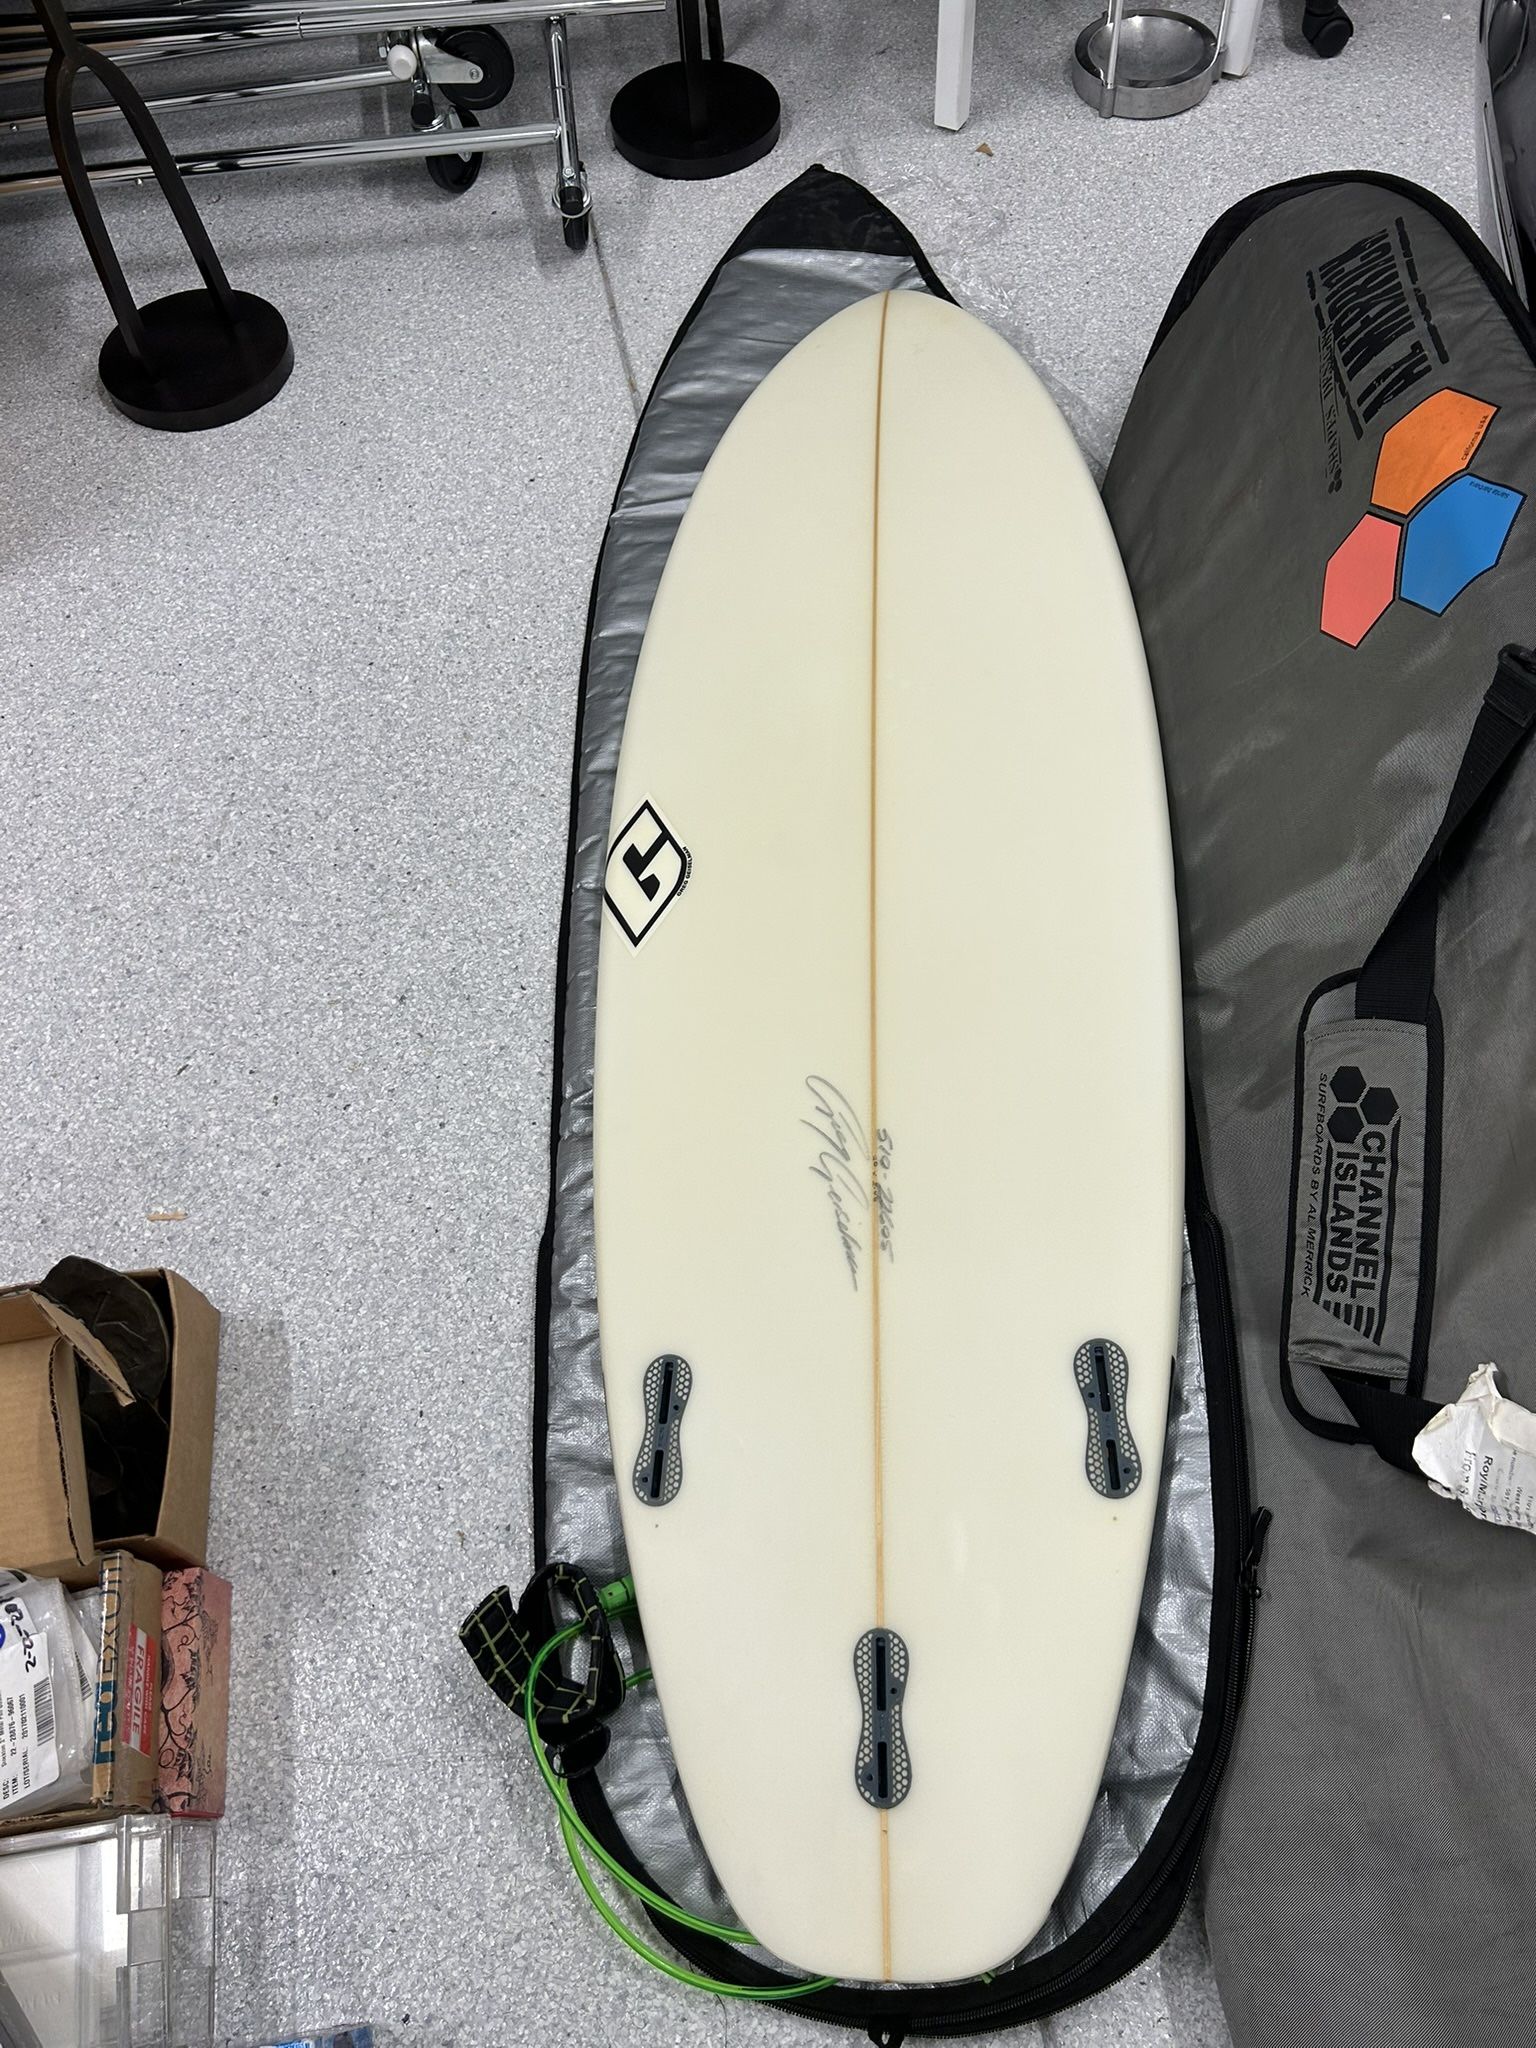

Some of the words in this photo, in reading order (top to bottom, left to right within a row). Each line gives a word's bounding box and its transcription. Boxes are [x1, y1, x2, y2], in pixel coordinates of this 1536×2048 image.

[676, 880, 689, 897] GREG
[683, 846, 693, 880] GEISELMAN
[1311, 1072, 1328, 1176] SURFBOARDS
[1307, 1203, 1317, 1224] AL
[1308, 1179, 1318, 1201] BY
[1350, 1131, 1386, 1299] CHANNEL
[1326, 1151, 1360, 1294] ISLANDS
[1301, 1227, 1315, 1299] MERRICK
[132, 1644, 145, 1735] FRAGILE
[2, 1778, 10, 1800] DESC:
[11, 1774, 19, 1796] ITEM:
[21, 1746, 31, 1789] LOT/SERIAL:
